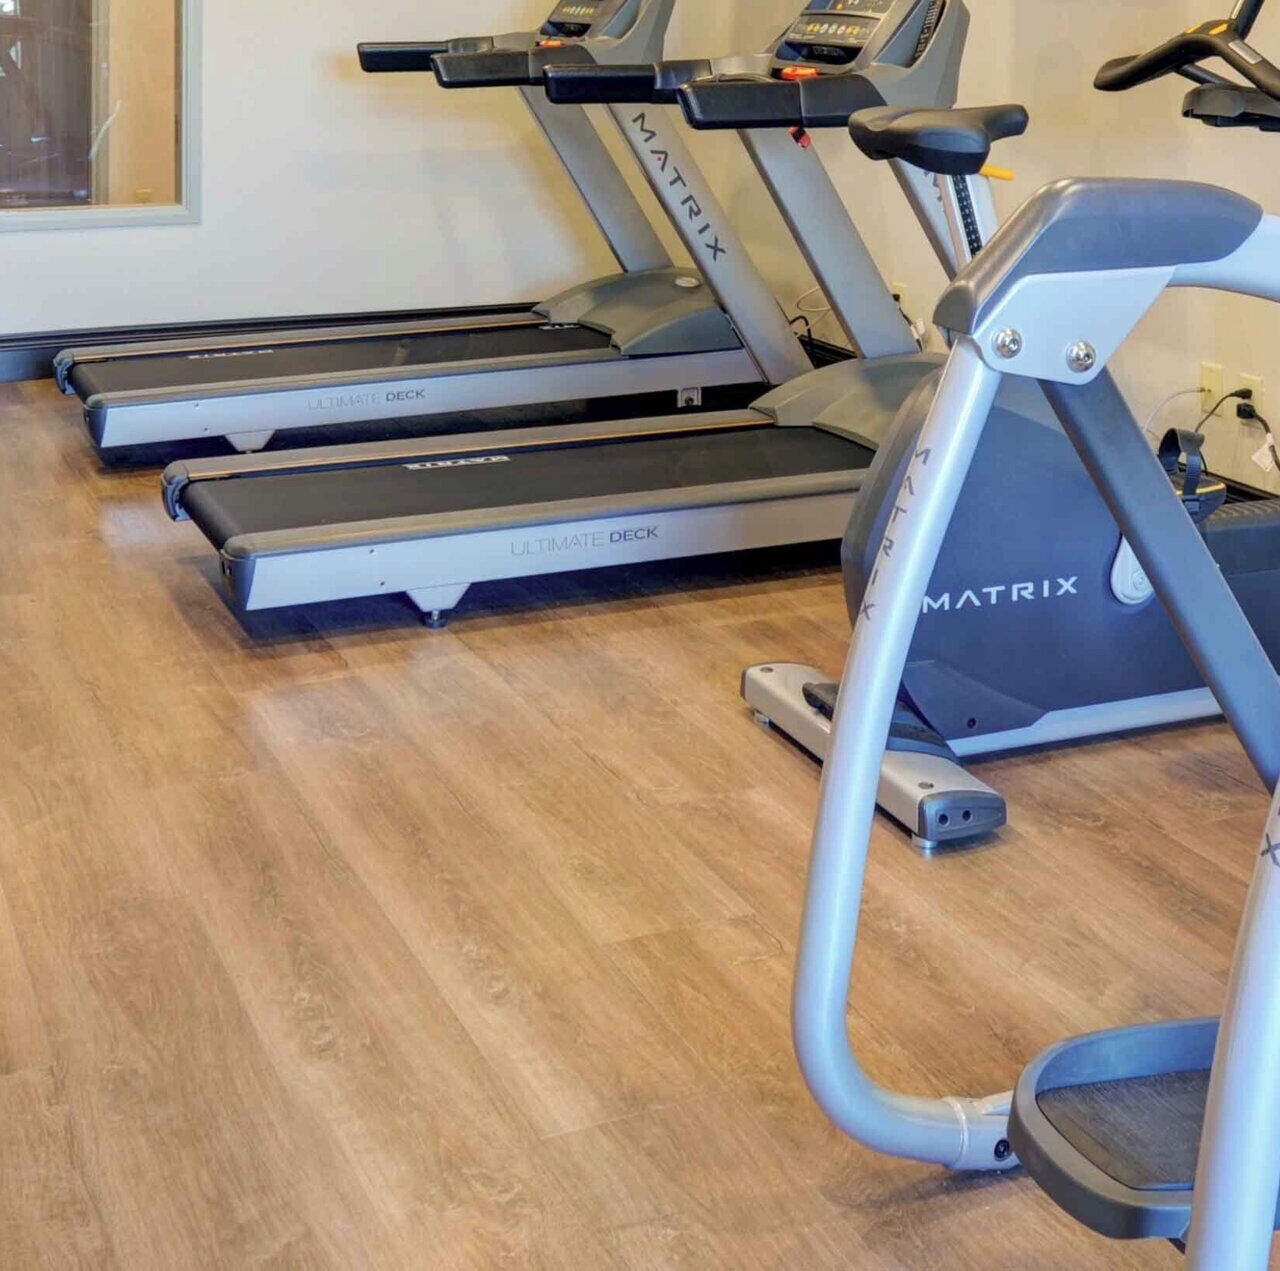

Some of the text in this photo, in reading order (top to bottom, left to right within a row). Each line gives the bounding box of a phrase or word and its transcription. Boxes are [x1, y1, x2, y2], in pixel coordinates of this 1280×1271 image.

[632, 112, 727, 263] MATRIX
[386, 389, 426, 402] DECK
[510, 525, 659, 556] ULTIMATE DECK
[860, 448, 931, 621] MATRIX
[923, 576, 1079, 614] MATRIX
